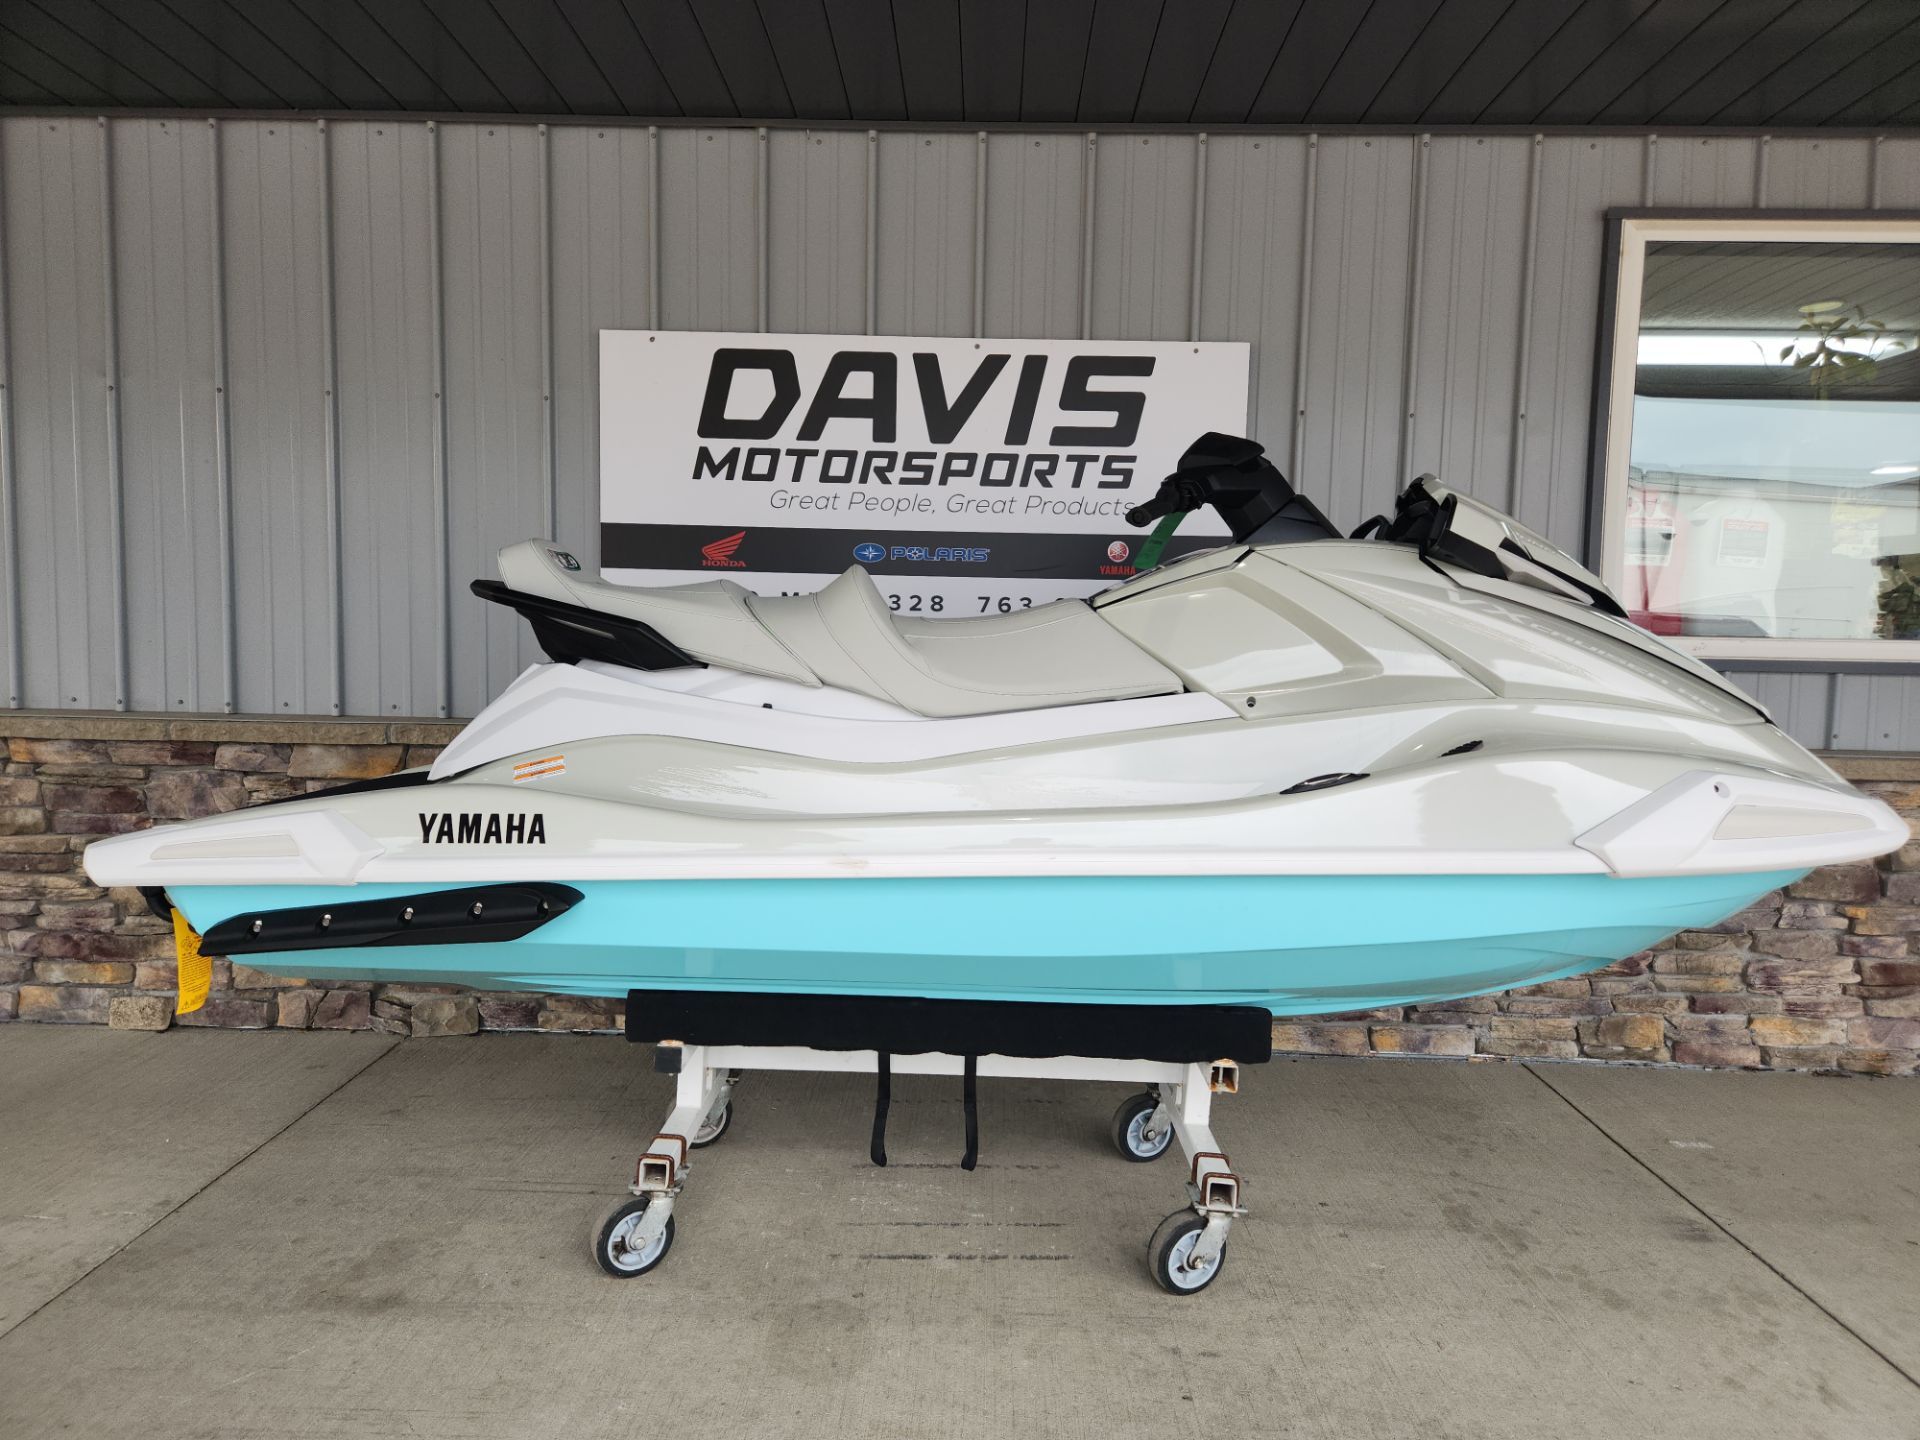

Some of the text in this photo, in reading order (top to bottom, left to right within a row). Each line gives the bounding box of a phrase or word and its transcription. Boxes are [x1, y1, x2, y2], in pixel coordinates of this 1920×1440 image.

[697, 348, 1157, 448] DAVIS
[691, 445, 1138, 490] MOTORSPORTS
[769, 489, 1139, 518] Great People, Great Products
[702, 559, 746, 568] HONDA
[890, 546, 988, 562] POLARIS
[1099, 565, 1136, 575] YAMAHA
[419, 813, 546, 844] YAMAHA
